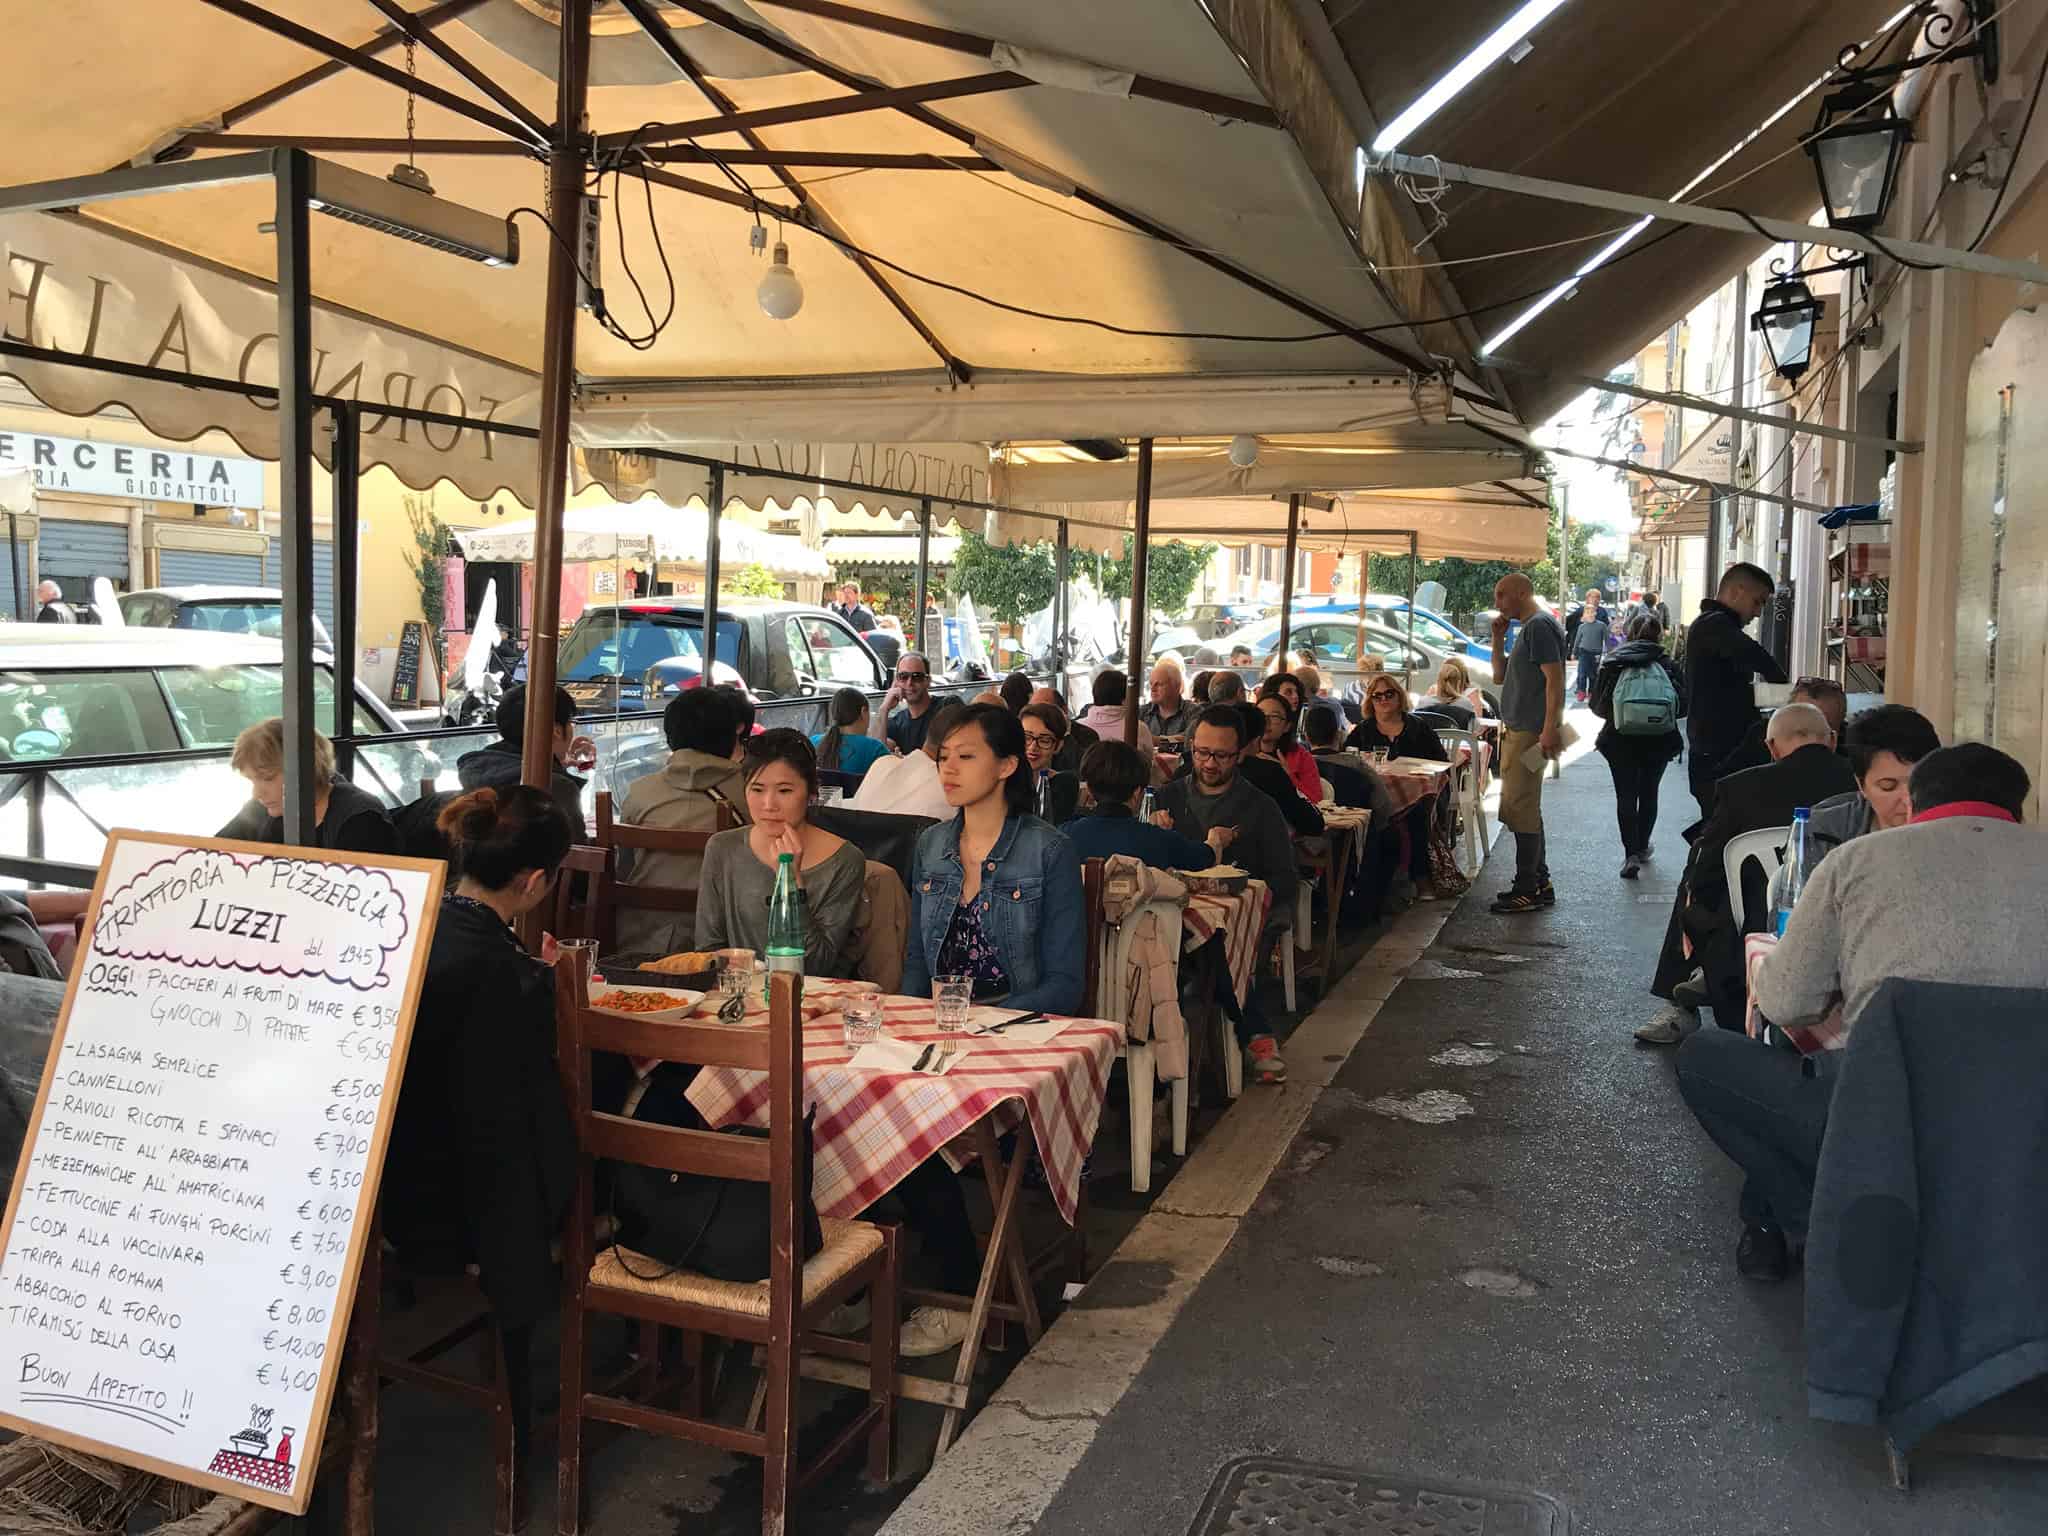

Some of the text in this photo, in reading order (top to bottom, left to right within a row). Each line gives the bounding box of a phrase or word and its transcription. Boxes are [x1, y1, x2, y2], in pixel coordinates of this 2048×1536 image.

[35, 468, 238, 503] RIA GIOCATTOLI
[97, 860, 388, 940] TRATTORIA PIZZERIA
[190, 898, 287, 943] LUZZI
[339, 944, 373, 965] 1945
[147, 968, 218, 992] PACCHERI
[223, 983, 238, 1000] AI
[243, 983, 285, 1002] FRUTTI
[288, 992, 299, 1011] DI
[307, 1000, 344, 1019] MARE
[150, 995, 221, 1028] GNOCCHI
[232, 1011, 251, 1037] DI
[264, 1016, 311, 1041] PATATE
[152, 1052, 219, 1078] SEMPLICE
[128, 1107, 185, 1133] RICOTTA
[198, 1120, 208, 1136] E
[218, 1122, 279, 1147] SPINACI
[128, 1203, 144, 1222] AI
[149, 1209, 203, 1232] FUNGHI
[209, 1218, 272, 1245] PORCINI
[78, 1227, 110, 1247] ALLA
[123, 1236, 204, 1266] VACCINARA
[71, 1257, 100, 1279] ALLA
[108, 1263, 164, 1292] ROMANA
[97, 1295, 113, 1316] AL
[122, 1301, 182, 1329] FORNO
[90, 1327, 129, 1350] DELLA
[139, 1338, 176, 1363] CASA
